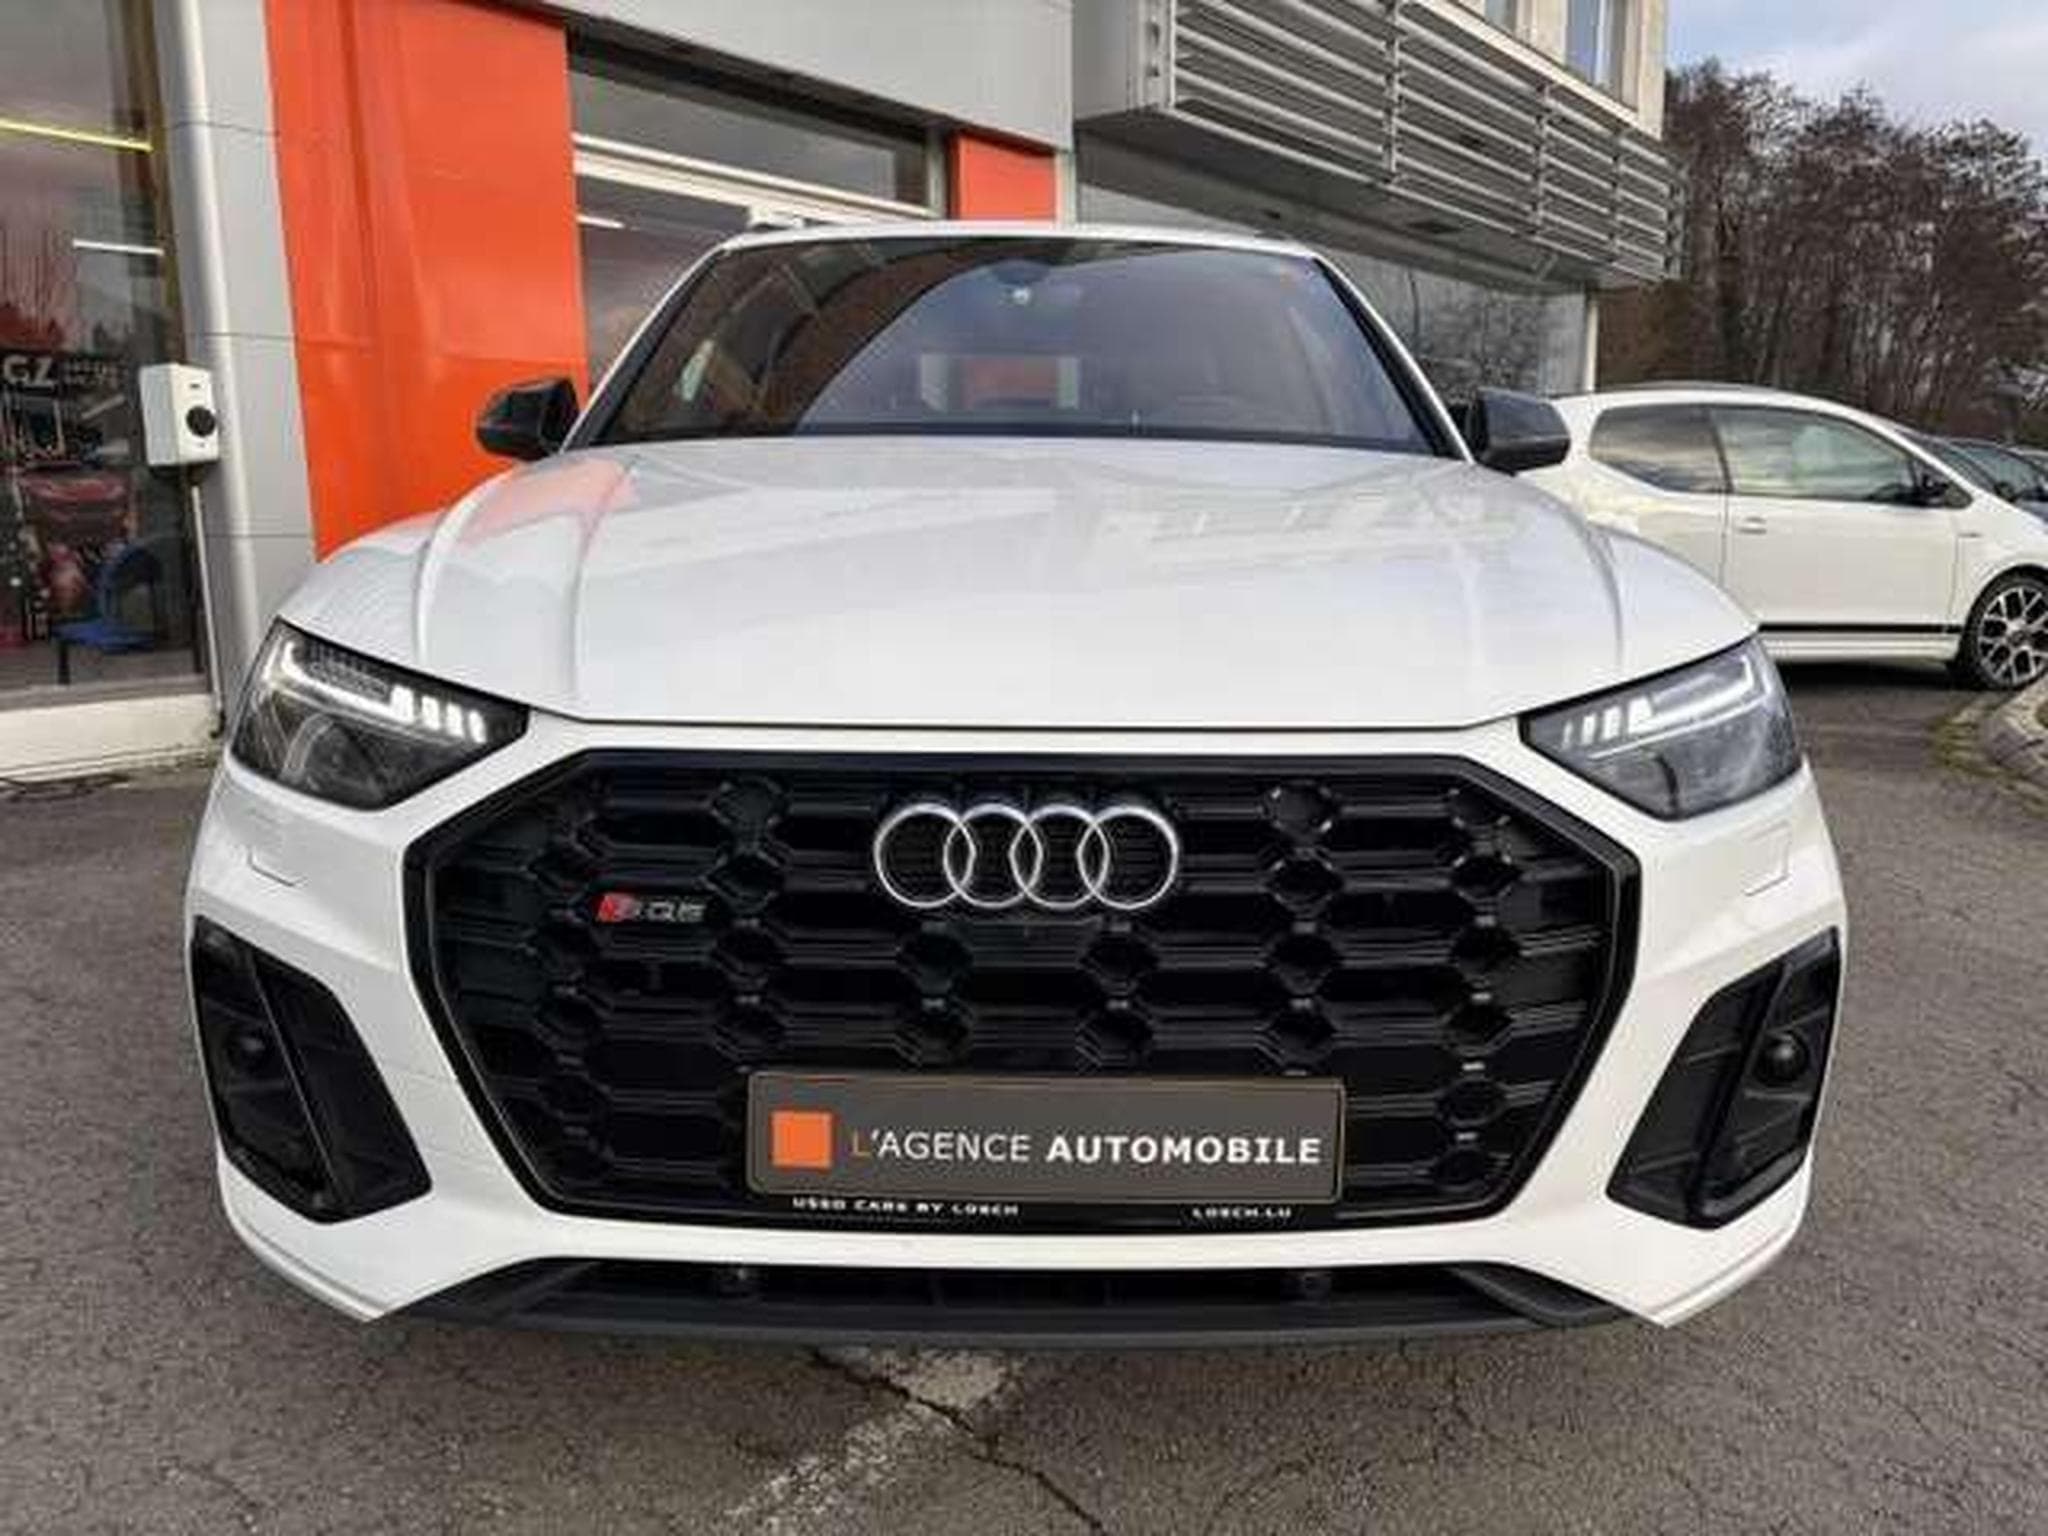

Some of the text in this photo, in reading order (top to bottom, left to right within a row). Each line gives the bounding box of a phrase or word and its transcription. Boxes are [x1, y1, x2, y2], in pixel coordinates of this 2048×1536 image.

[852, 1128, 1321, 1164] L'AGENCE AUTOMOBILE
[854, 1199, 908, 1212] CARS
[916, 1202, 944, 1214] BY
